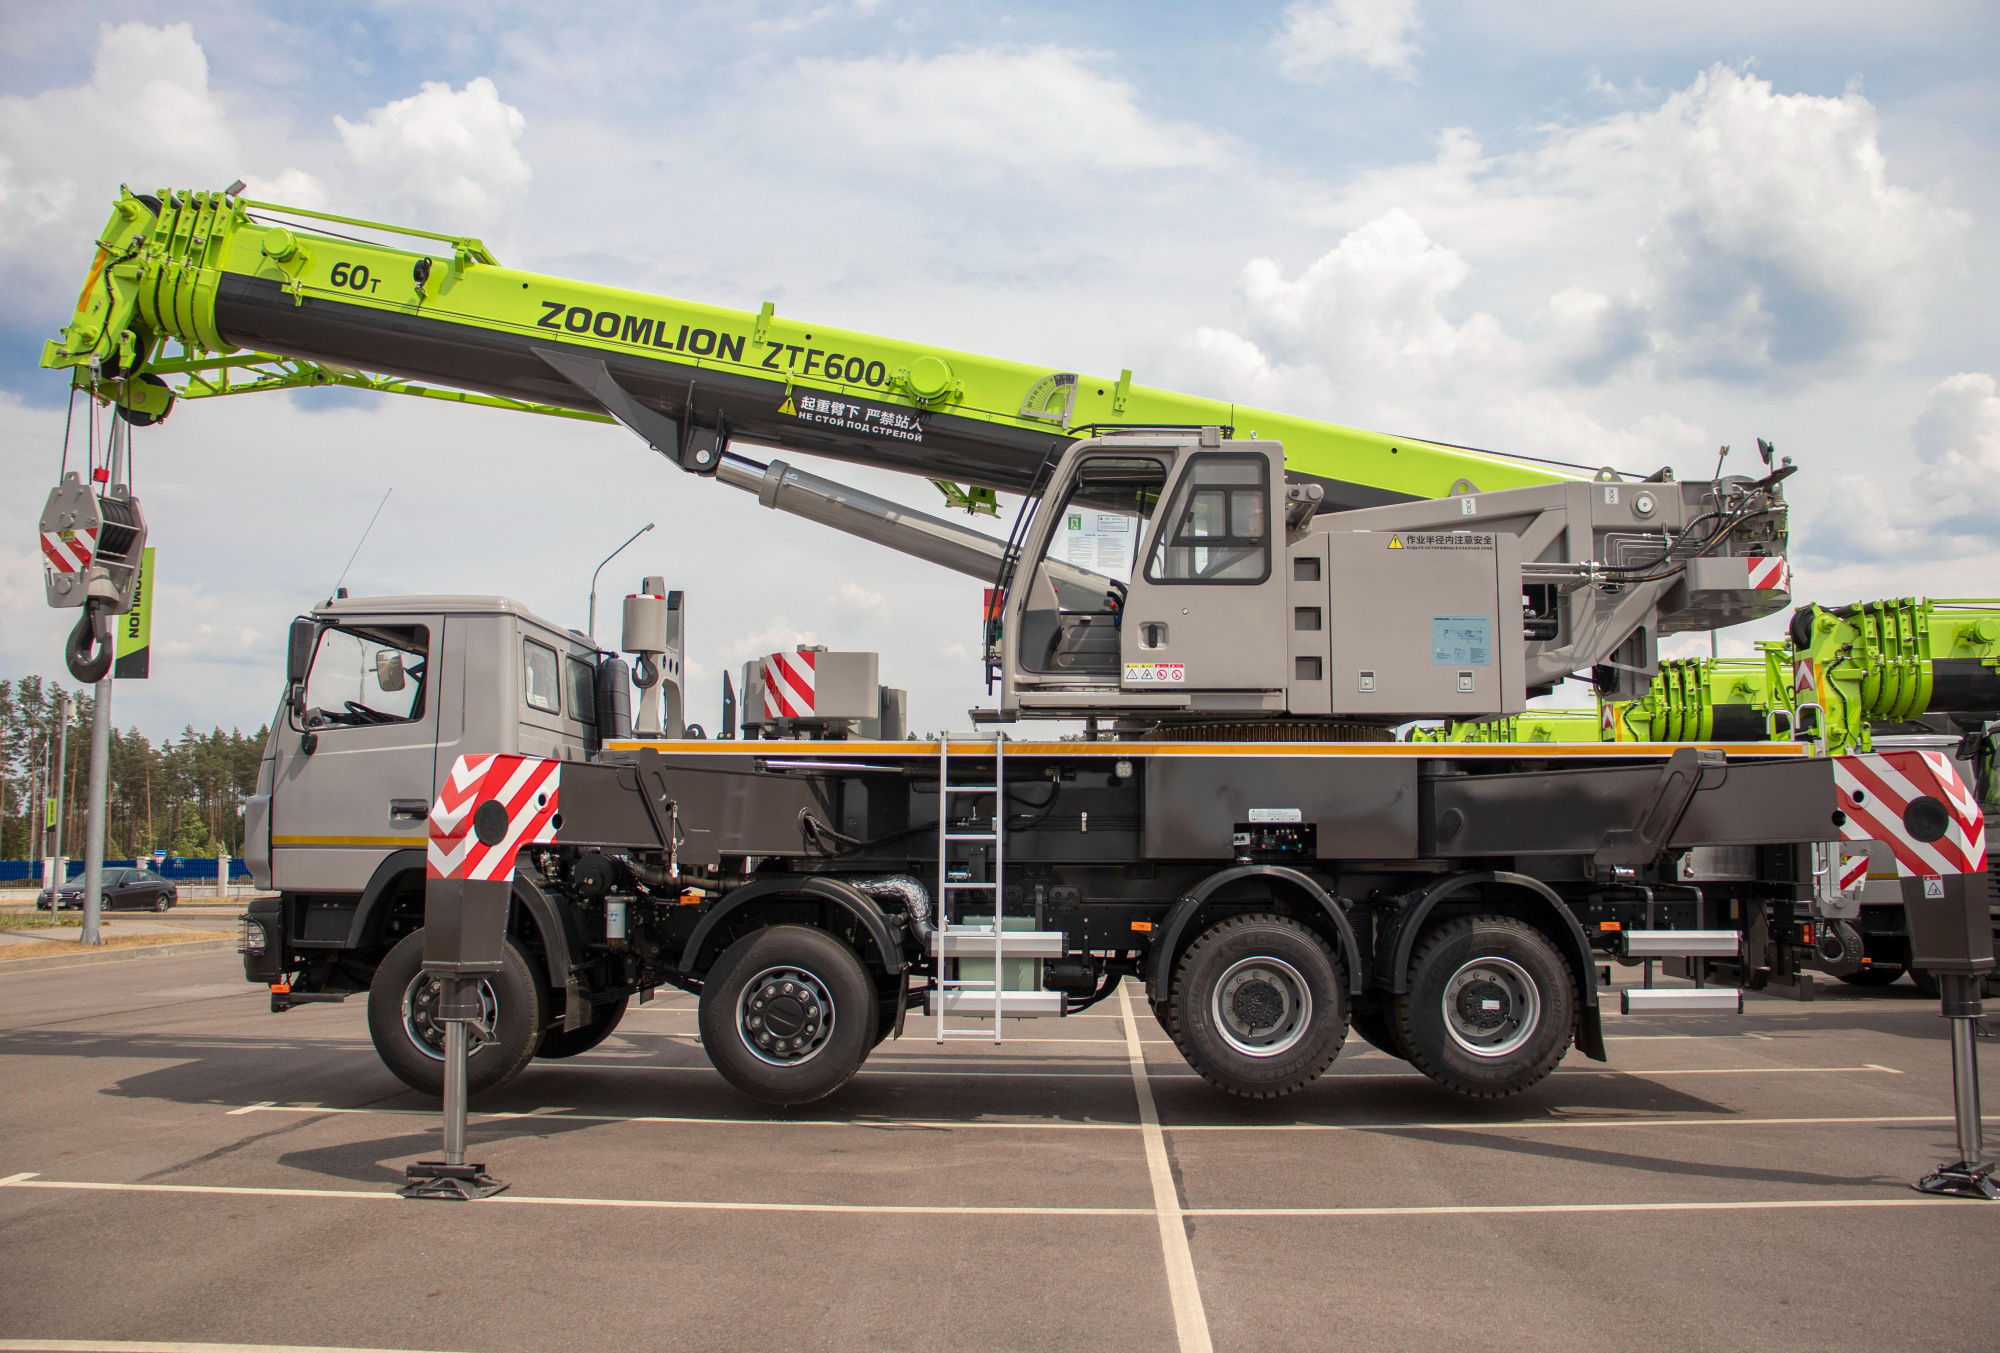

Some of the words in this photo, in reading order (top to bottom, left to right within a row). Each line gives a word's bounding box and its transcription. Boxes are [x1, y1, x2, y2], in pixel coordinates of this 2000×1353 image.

[537, 301, 746, 362] ZOOMLION
[762, 341, 886, 387] ZTF600
[798, 411, 813, 421] НЕ
[815, 414, 844, 427] СТОЙ
[846, 420, 870, 433] ПОД
[872, 425, 923, 442] СТРЕЛОЙ
[800, 395, 861, 419] 起重臂下
[865, 407, 923, 432] 严禁站人
[1406, 535, 1492, 545] 作业半径内注意安全
